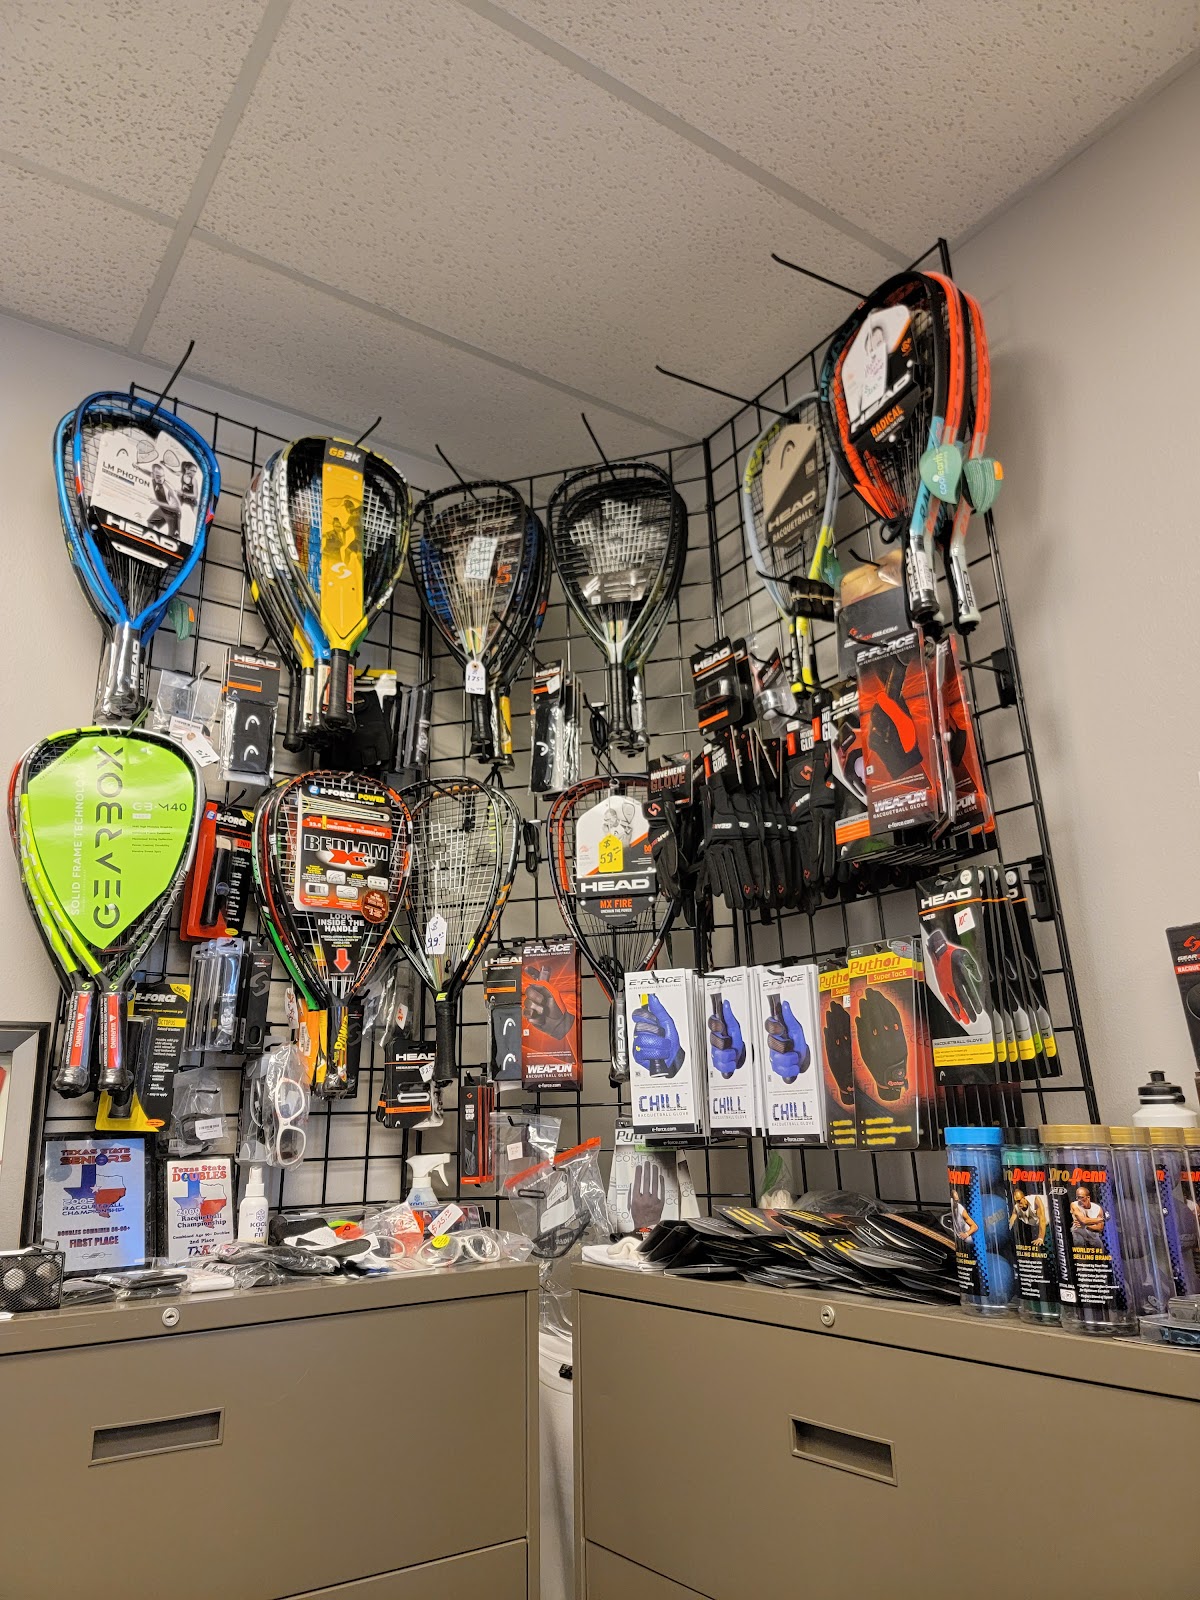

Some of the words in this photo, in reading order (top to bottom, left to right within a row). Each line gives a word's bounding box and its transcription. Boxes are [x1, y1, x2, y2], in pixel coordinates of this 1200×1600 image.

[851, 372, 911, 434] HEAD
[870, 405, 905, 437] RADICAL
[328, 446, 362, 464] GB3K
[102, 461, 115, 471] LM
[116, 467, 150, 488] PHOTON
[768, 487, 817, 533] HEAD
[106, 514, 180, 552] HEAD
[772, 508, 814, 543] RACQUETBALL
[129, 639, 140, 690] HEAD
[233, 653, 277, 668] HEAD
[693, 646, 731, 673] HEAD
[832, 690, 859, 710] HEA
[650, 765, 686, 780] MOVEMENT
[650, 774, 686, 791] GLOVE
[320, 787, 356, 799] E-FORCE
[357, 793, 386, 804] POWER
[872, 789, 927, 813] WEAPON
[872, 806, 909, 819] RACQUETBALL
[909, 801, 929, 810] GLOVE
[216, 814, 248, 827] E-FORCE
[887, 818, 915, 829] e-force.com
[93, 745, 124, 929] GEARBOX
[303, 834, 389, 862] BEDLAM
[72, 841, 82, 878] FRAME
[580, 878, 650, 893] HEAD
[71, 882, 81, 915] SOLID
[600, 899, 612, 909] MX
[614, 898, 633, 908] FIRE
[921, 887, 972, 909] HEAD
[349, 919, 365, 927] THE
[523, 943, 573, 954] E-FORCE
[850, 956, 900, 975] Python
[1177, 965, 1200, 973] RACQUE
[629, 975, 683, 986] E-FORCE
[706, 974, 744, 987] E-FORCE
[763, 974, 805, 987] E-FORCE
[819, 972, 849, 988] Pytho
[873, 972, 891, 981] Super
[891, 970, 907, 978] Tack
[135, 993, 177, 1003] E-FORCE
[159, 1018, 176, 1026] OCTOPUS
[74, 1020, 85, 1048] WARNING
[526, 1063, 573, 1074] WEAPON
[638, 1093, 687, 1113] CHILL
[712, 1096, 746, 1115] CHILL
[772, 1101, 813, 1121] CHILL
[60, 1148, 98, 1156] TEXAS
[60, 1153, 132, 1166] SENIORS
[172, 1171, 227, 1182] DOUBLES
[948, 1168, 971, 1186] enn
[1012, 1167, 1046, 1185] Penn
[1068, 1167, 1107, 1186] Penn
[62, 1203, 123, 1211] RACQUETBALL
[62, 1208, 125, 1216] CHAMPIONSHIP
[176, 1208, 200, 1216] 2009
[177, 1219, 227, 1228] Championship
[181, 1213, 222, 1221] Racquetball
[69, 1237, 93, 1248] FIRST
[94, 1235, 119, 1246] PLACE
[187, 1244, 217, 1256] TXR
[1056, 1224, 1069, 1281] DEFINITION
